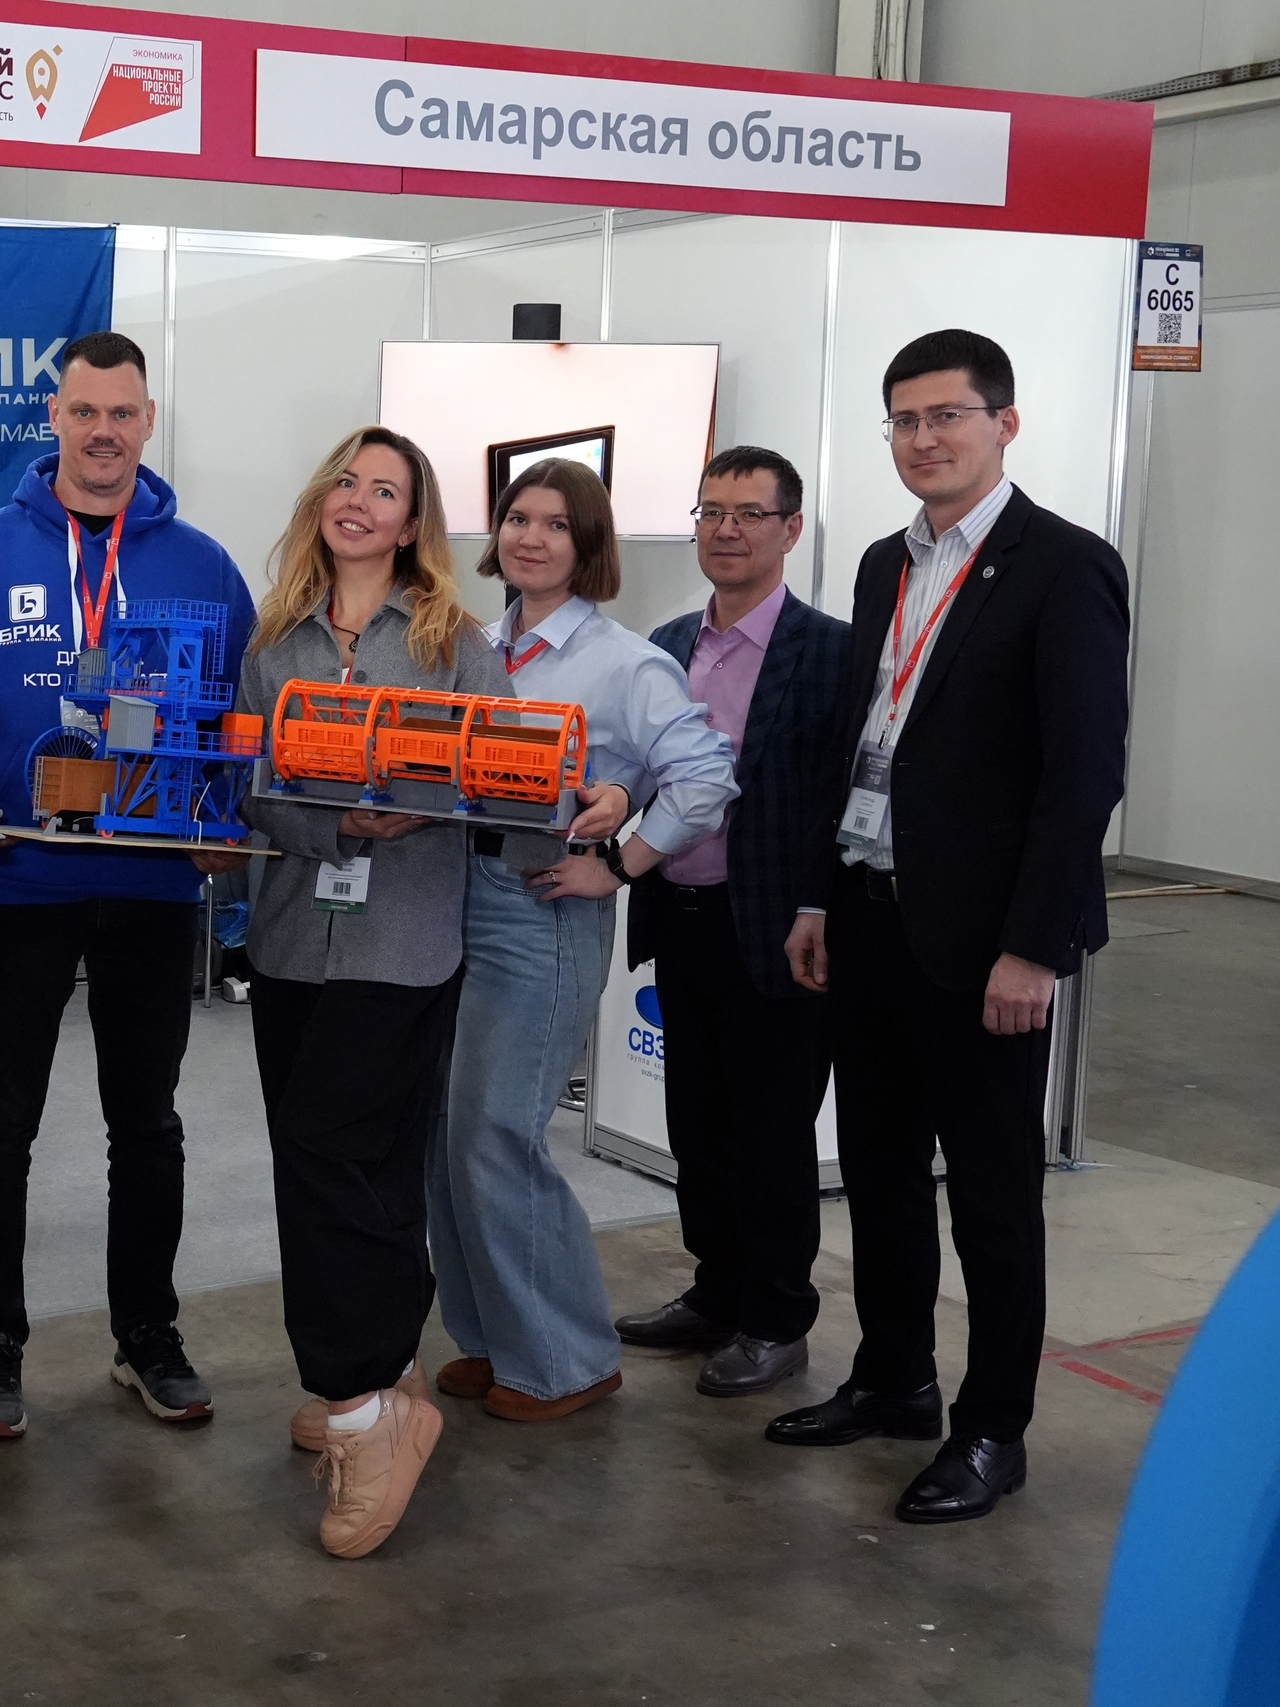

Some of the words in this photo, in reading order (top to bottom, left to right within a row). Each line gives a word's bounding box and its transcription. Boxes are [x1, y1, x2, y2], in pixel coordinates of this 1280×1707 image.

[132, 49, 183, 61] ЭКОНОМИКА
[113, 65, 182, 83] НАЦИОНАЛЬНЫЕ
[142, 81, 182, 95] ПРОЕКТЫ
[149, 93, 181, 107] РОССИИ
[374, 79, 689, 160] Самарская
[708, 110, 922, 172] область
[1147, 289, 1194, 312] 6065
[0, 624, 61, 642] БРИК
[24, 673, 61, 687] КТО
[628, 1027, 665, 1060] СВЗ
